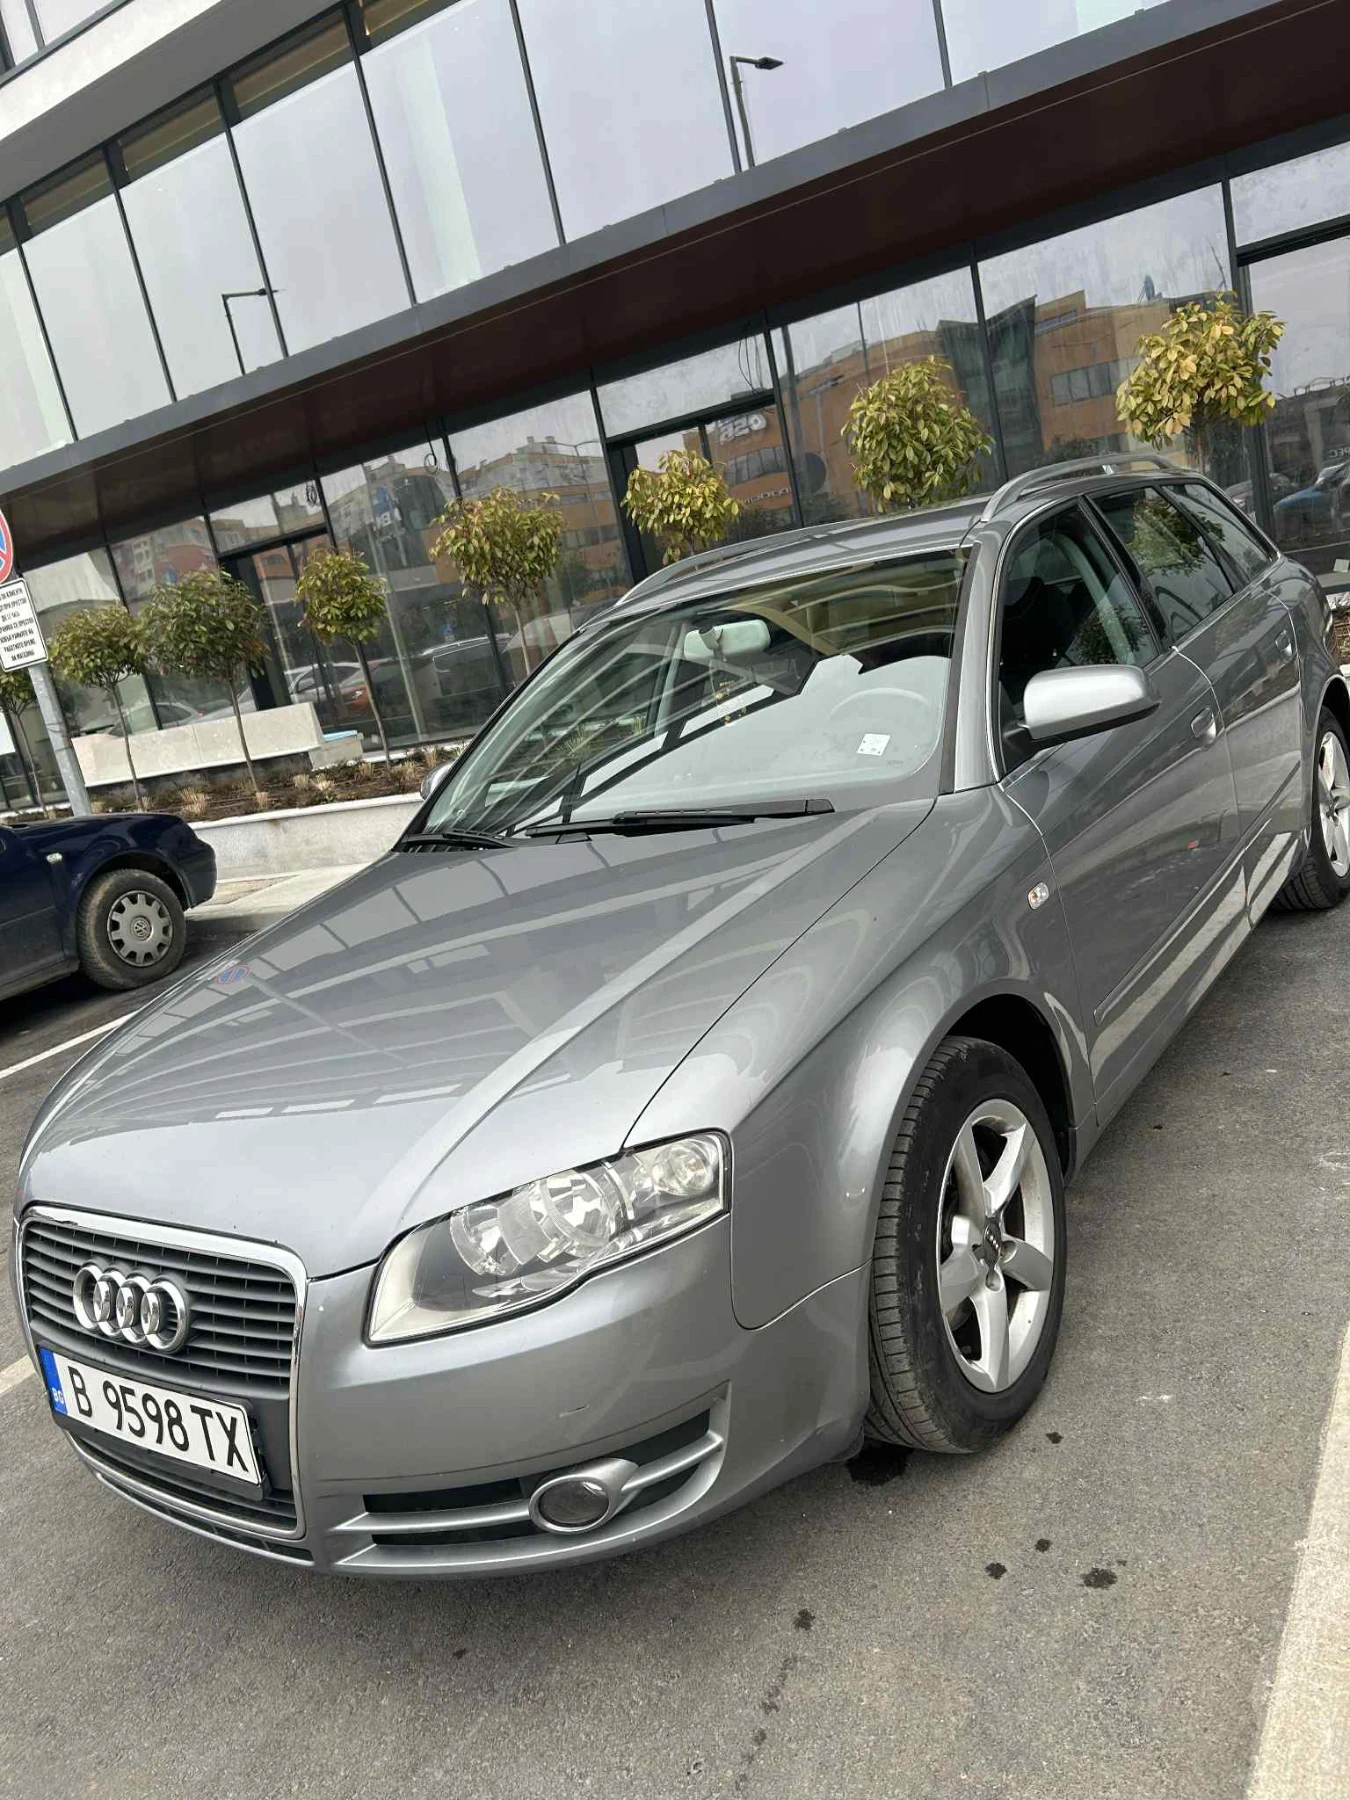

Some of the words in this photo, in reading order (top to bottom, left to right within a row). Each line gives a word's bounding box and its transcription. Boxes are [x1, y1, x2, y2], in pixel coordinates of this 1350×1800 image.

[68, 1365, 93, 1418] B
[102, 1380, 190, 1452] 9598
[190, 1403, 249, 1473] TX
